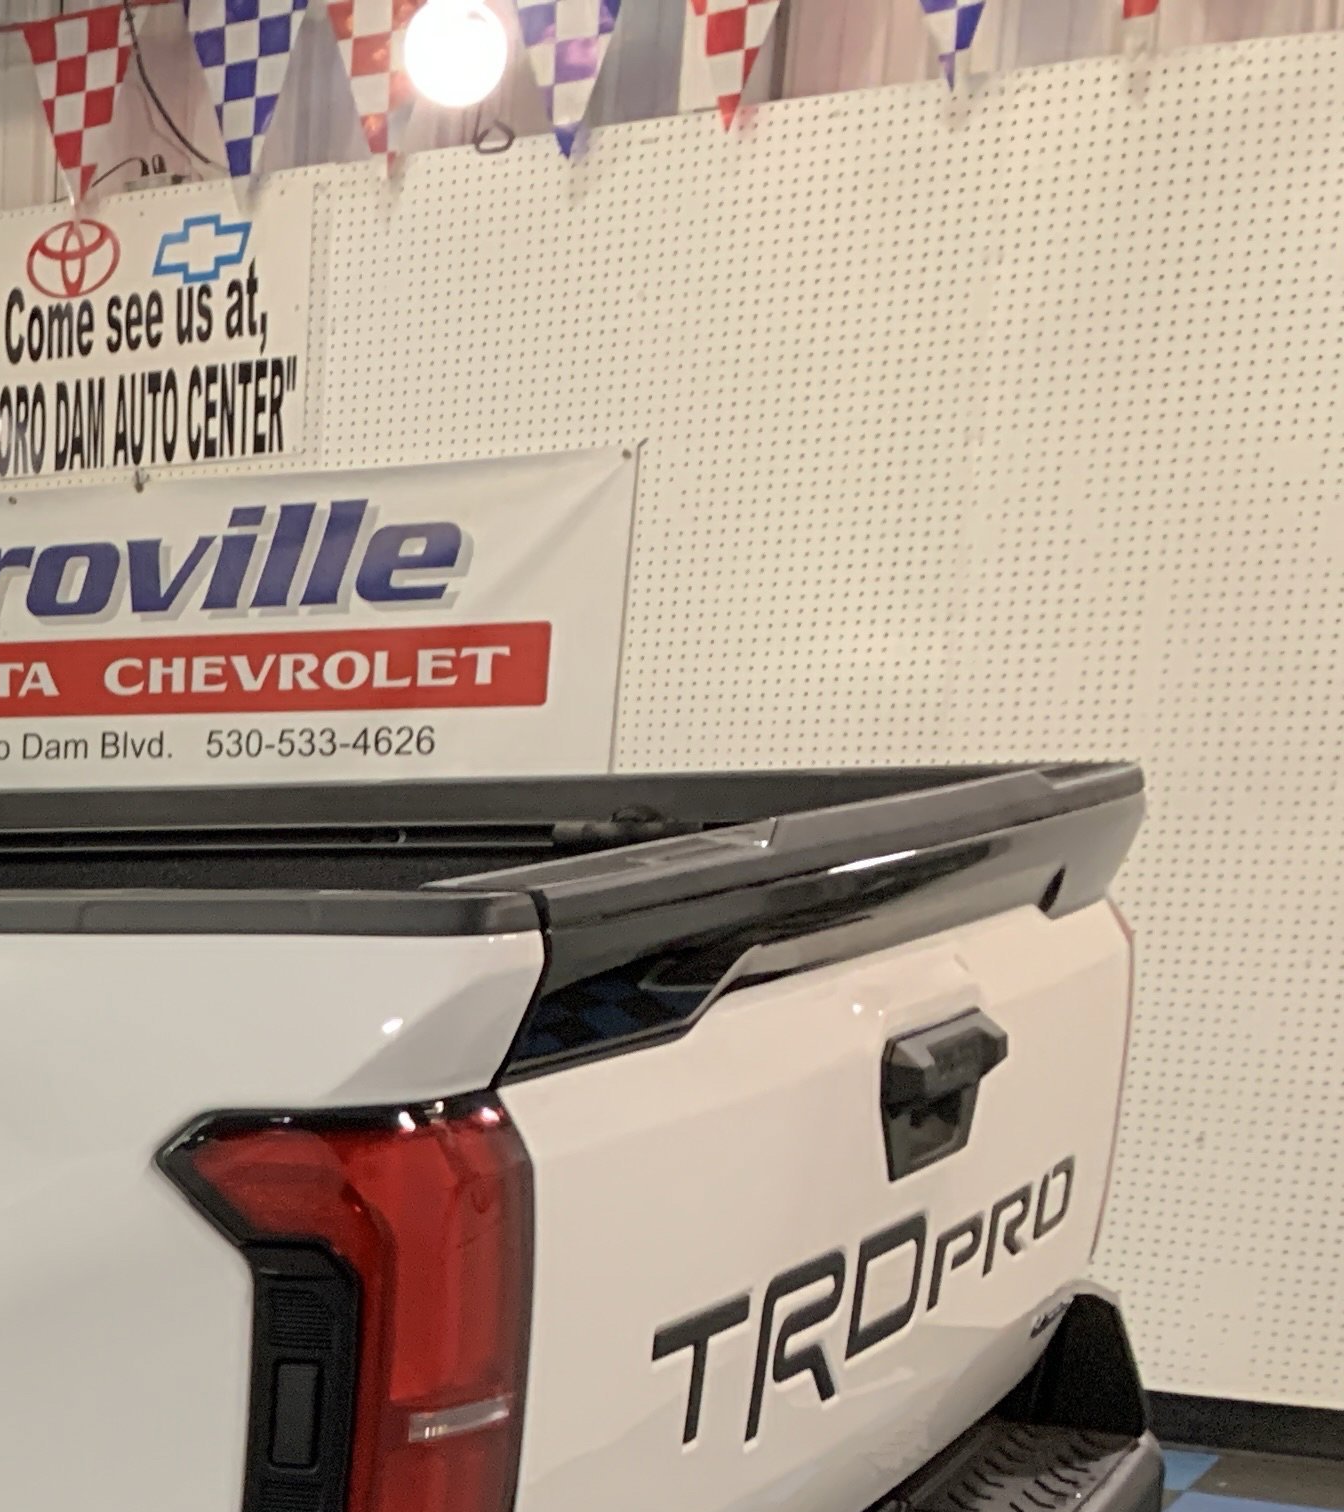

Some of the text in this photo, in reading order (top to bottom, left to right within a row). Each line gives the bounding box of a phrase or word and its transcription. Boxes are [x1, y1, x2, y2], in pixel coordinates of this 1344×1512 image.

[5, 257, 267, 365] Come see us at,
[54, 377, 105, 471] DAM
[114, 367, 180, 466] AUTO
[187, 356, 297, 461] CENTER"
[103, 646, 511, 697] CHEVROLET
[21, 731, 89, 761] Dam
[100, 728, 173, 760] Blvd.
[206, 725, 436, 760] 530-533-4626
[651, 1154, 1076, 1446] TRD PRO
